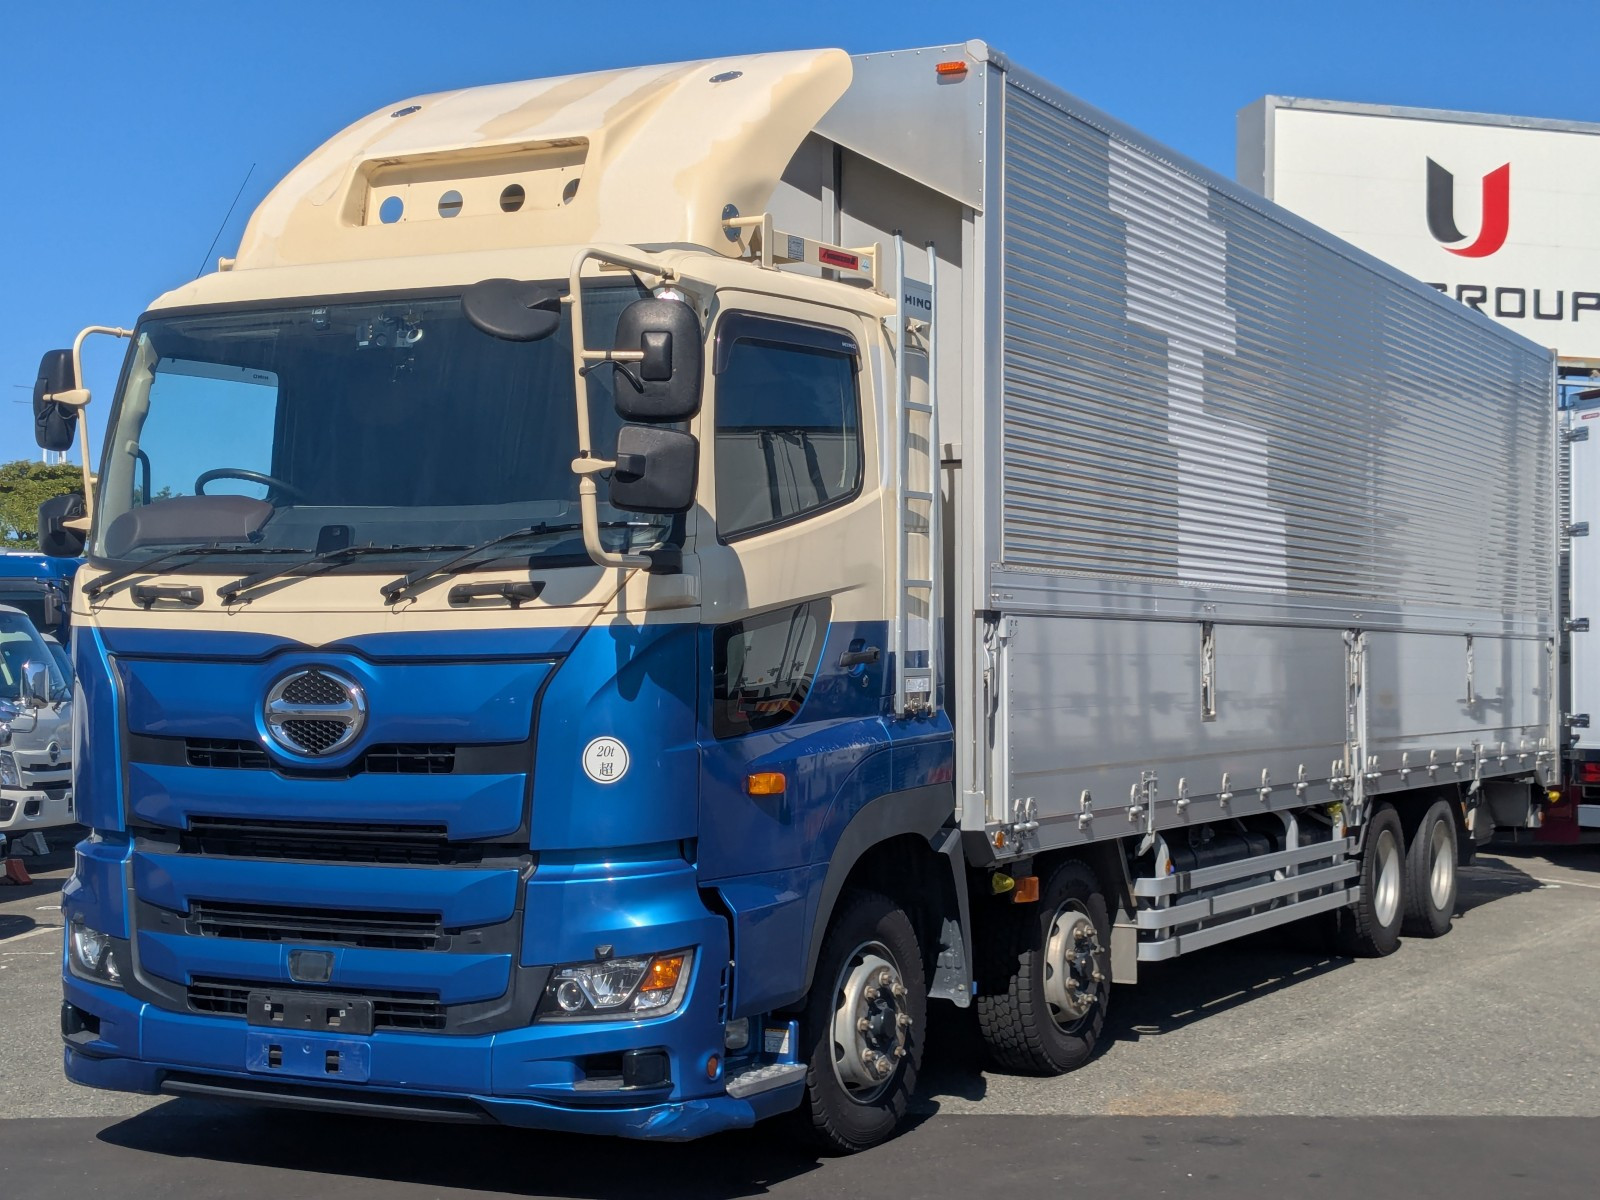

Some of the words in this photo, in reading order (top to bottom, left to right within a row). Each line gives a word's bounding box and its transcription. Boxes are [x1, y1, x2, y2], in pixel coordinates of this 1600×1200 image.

[1426, 155, 1510, 258] U
[905, 294, 931, 310] HINO
[1424, 283, 1600, 321] ROUP
[597, 746, 614, 757] 20t
